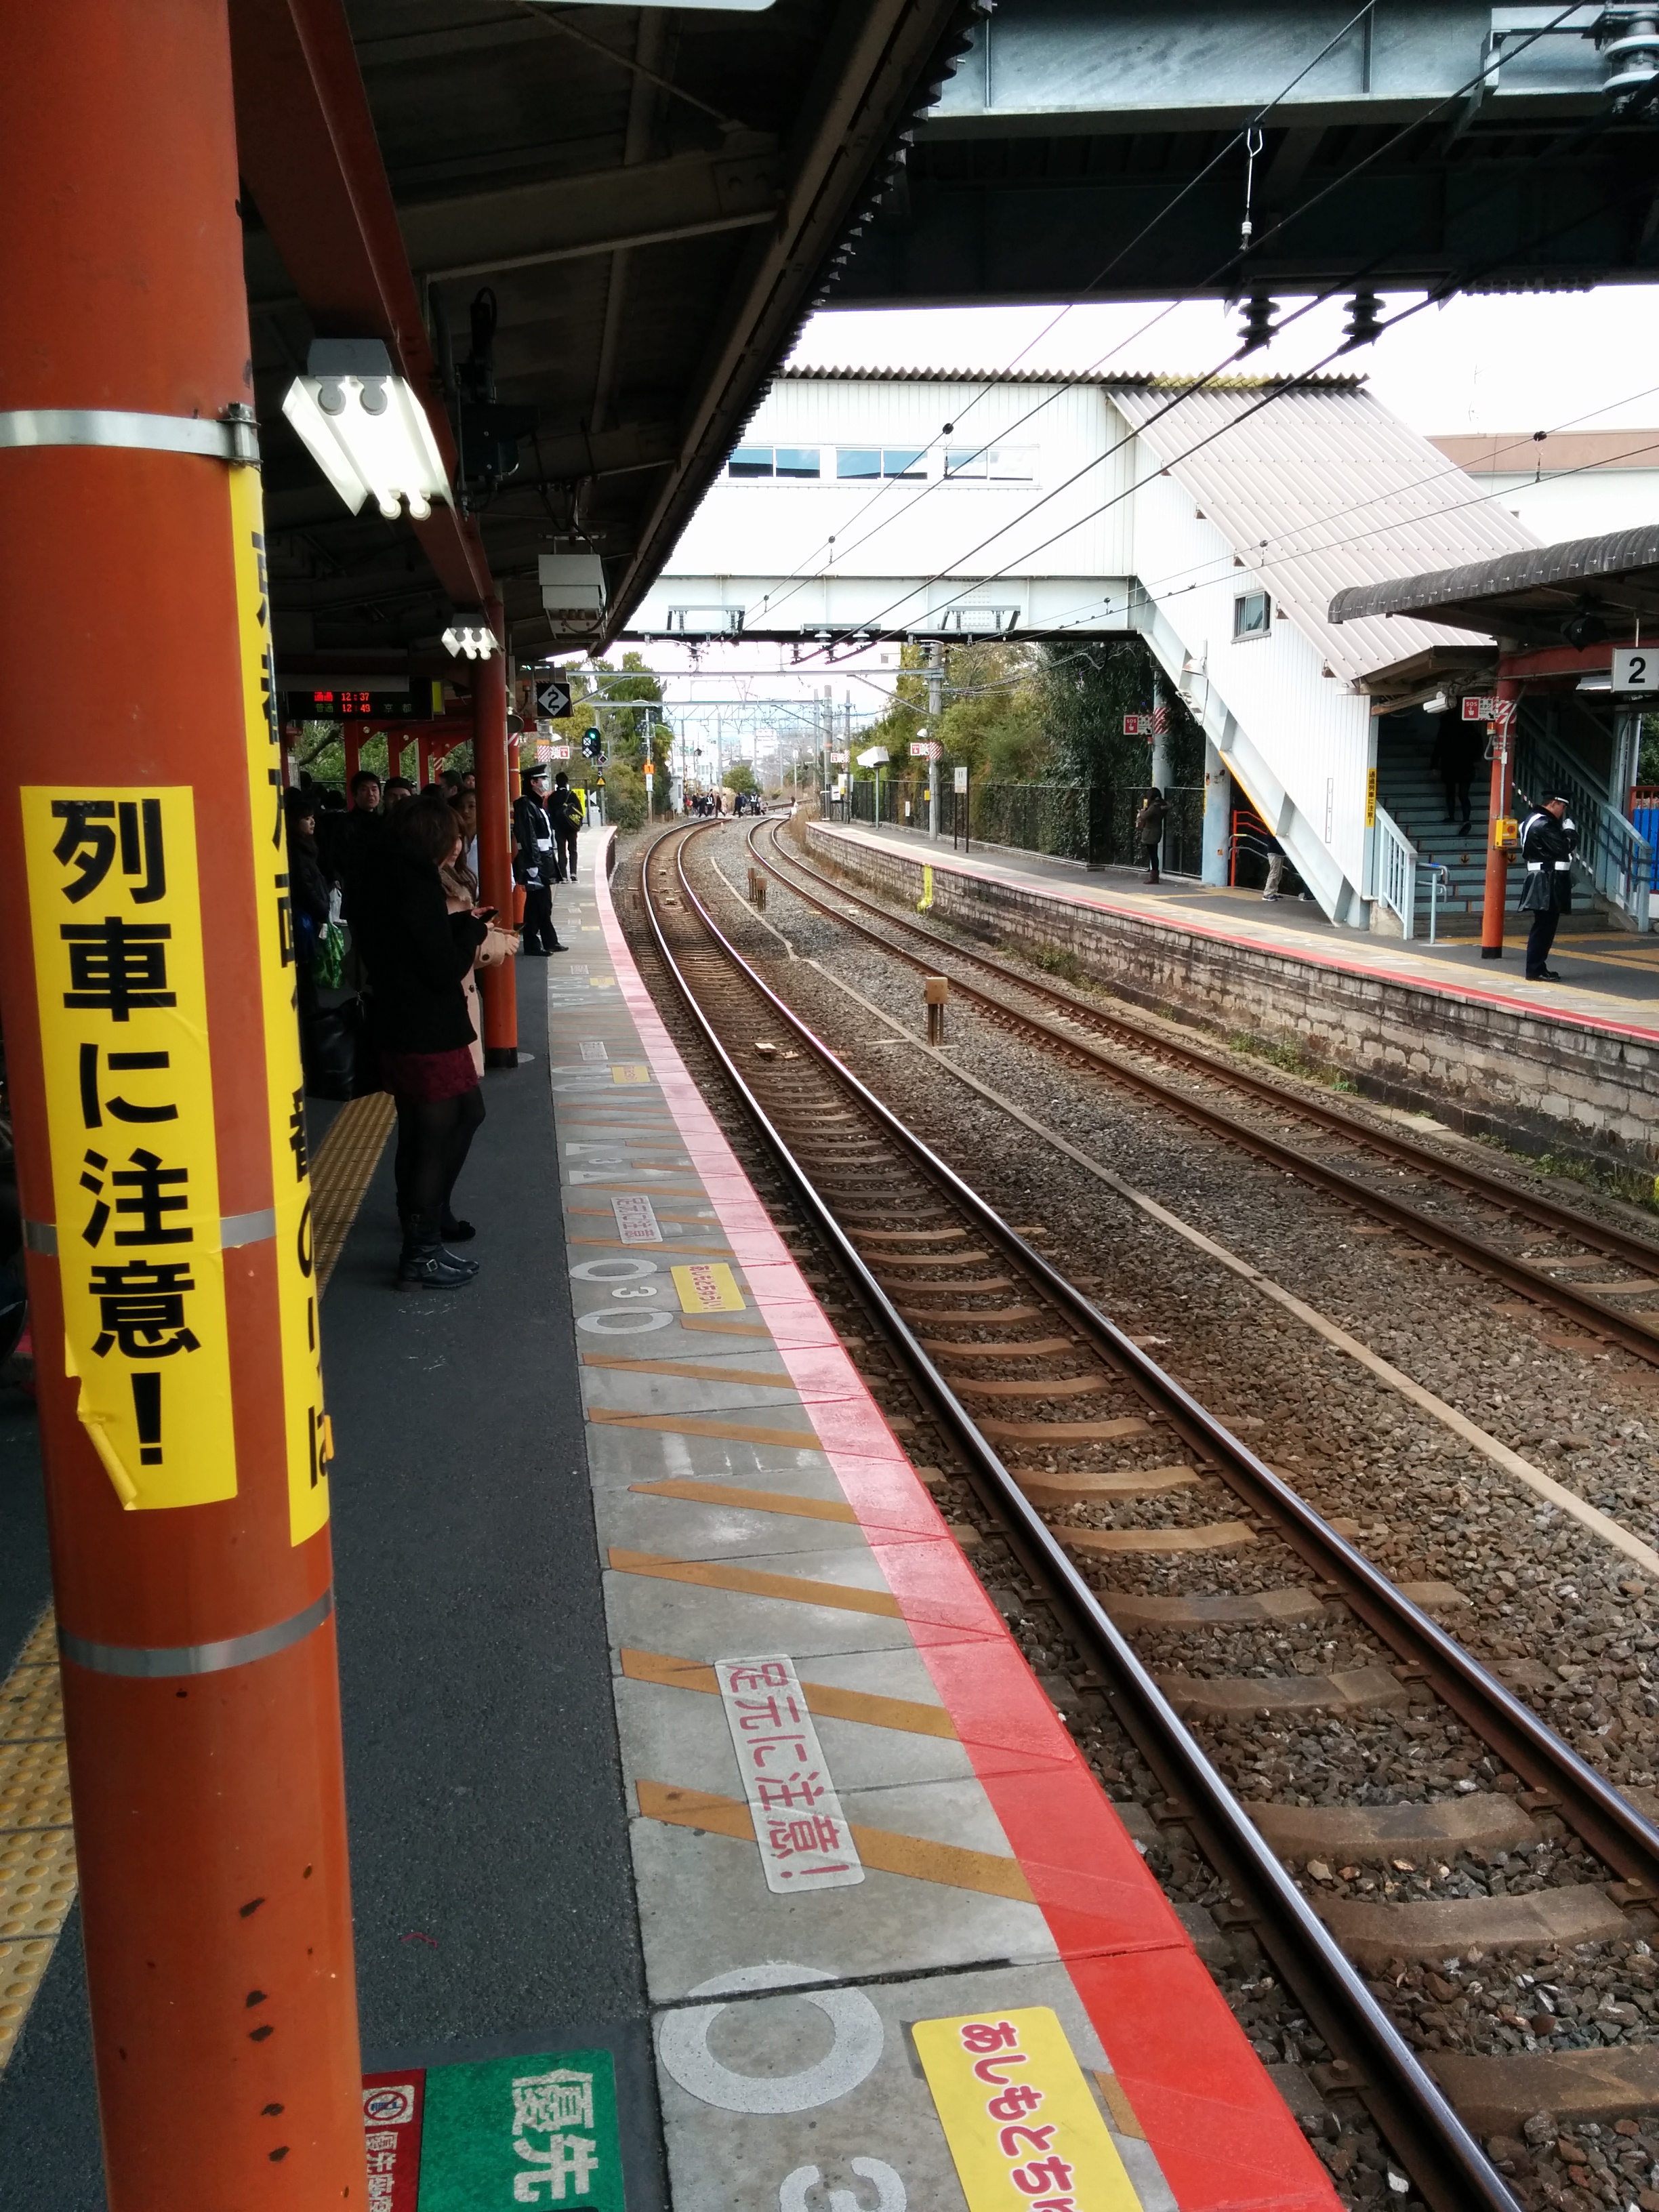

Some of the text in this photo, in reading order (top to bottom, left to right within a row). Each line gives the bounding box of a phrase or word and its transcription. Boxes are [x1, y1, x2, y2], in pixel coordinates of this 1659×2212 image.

[341, 692, 370, 701] 12:37
[547, 691, 560, 709] 2
[1628, 656, 1646, 684] 2
[51, 798, 202, 1466] 列車に注意!
[726, 1662, 850, 1879] 足元に注意!
[512, 2068, 599, 2203] 優先
